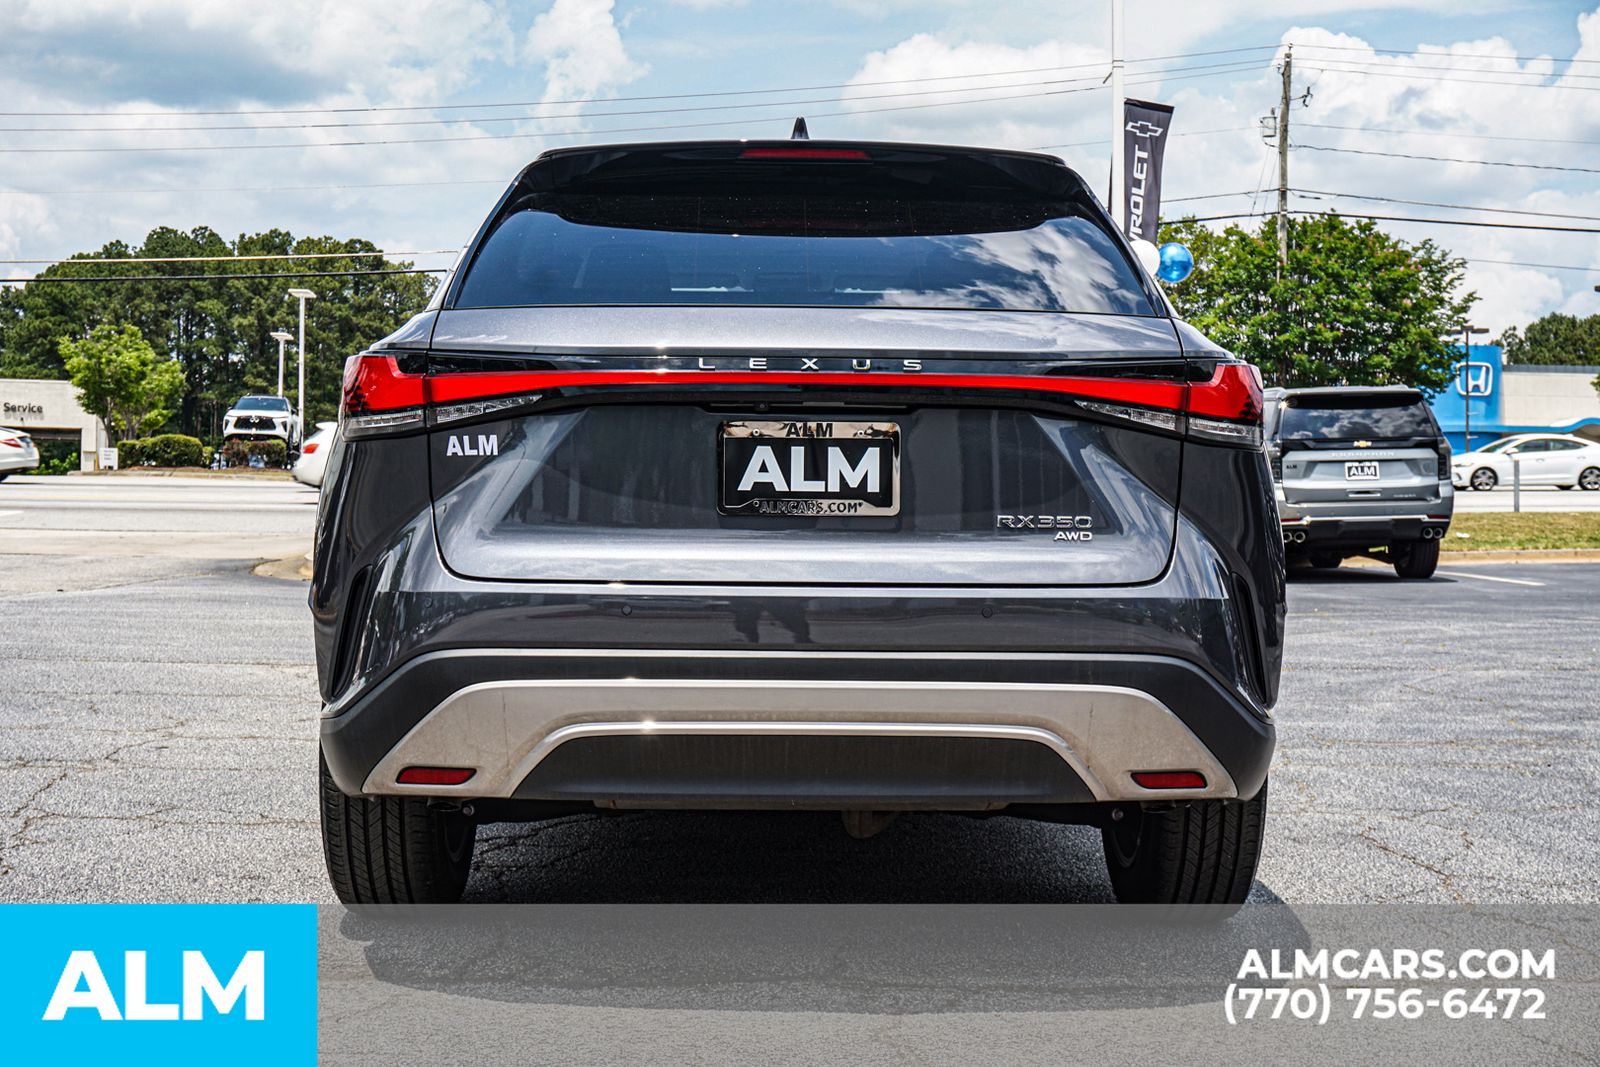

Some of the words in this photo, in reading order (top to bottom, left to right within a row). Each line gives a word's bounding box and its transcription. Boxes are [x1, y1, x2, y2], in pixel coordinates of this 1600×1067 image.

[698, 357, 922, 371] LEXUS
[3, 402, 43, 414] Service
[786, 423, 833, 437] ALM
[446, 434, 499, 456] ALM
[737, 445, 880, 493] ALM
[1350, 466, 1376, 477] ALM
[759, 500, 858, 514] ALMCARS.COM
[1054, 531, 1093, 541] AWD
